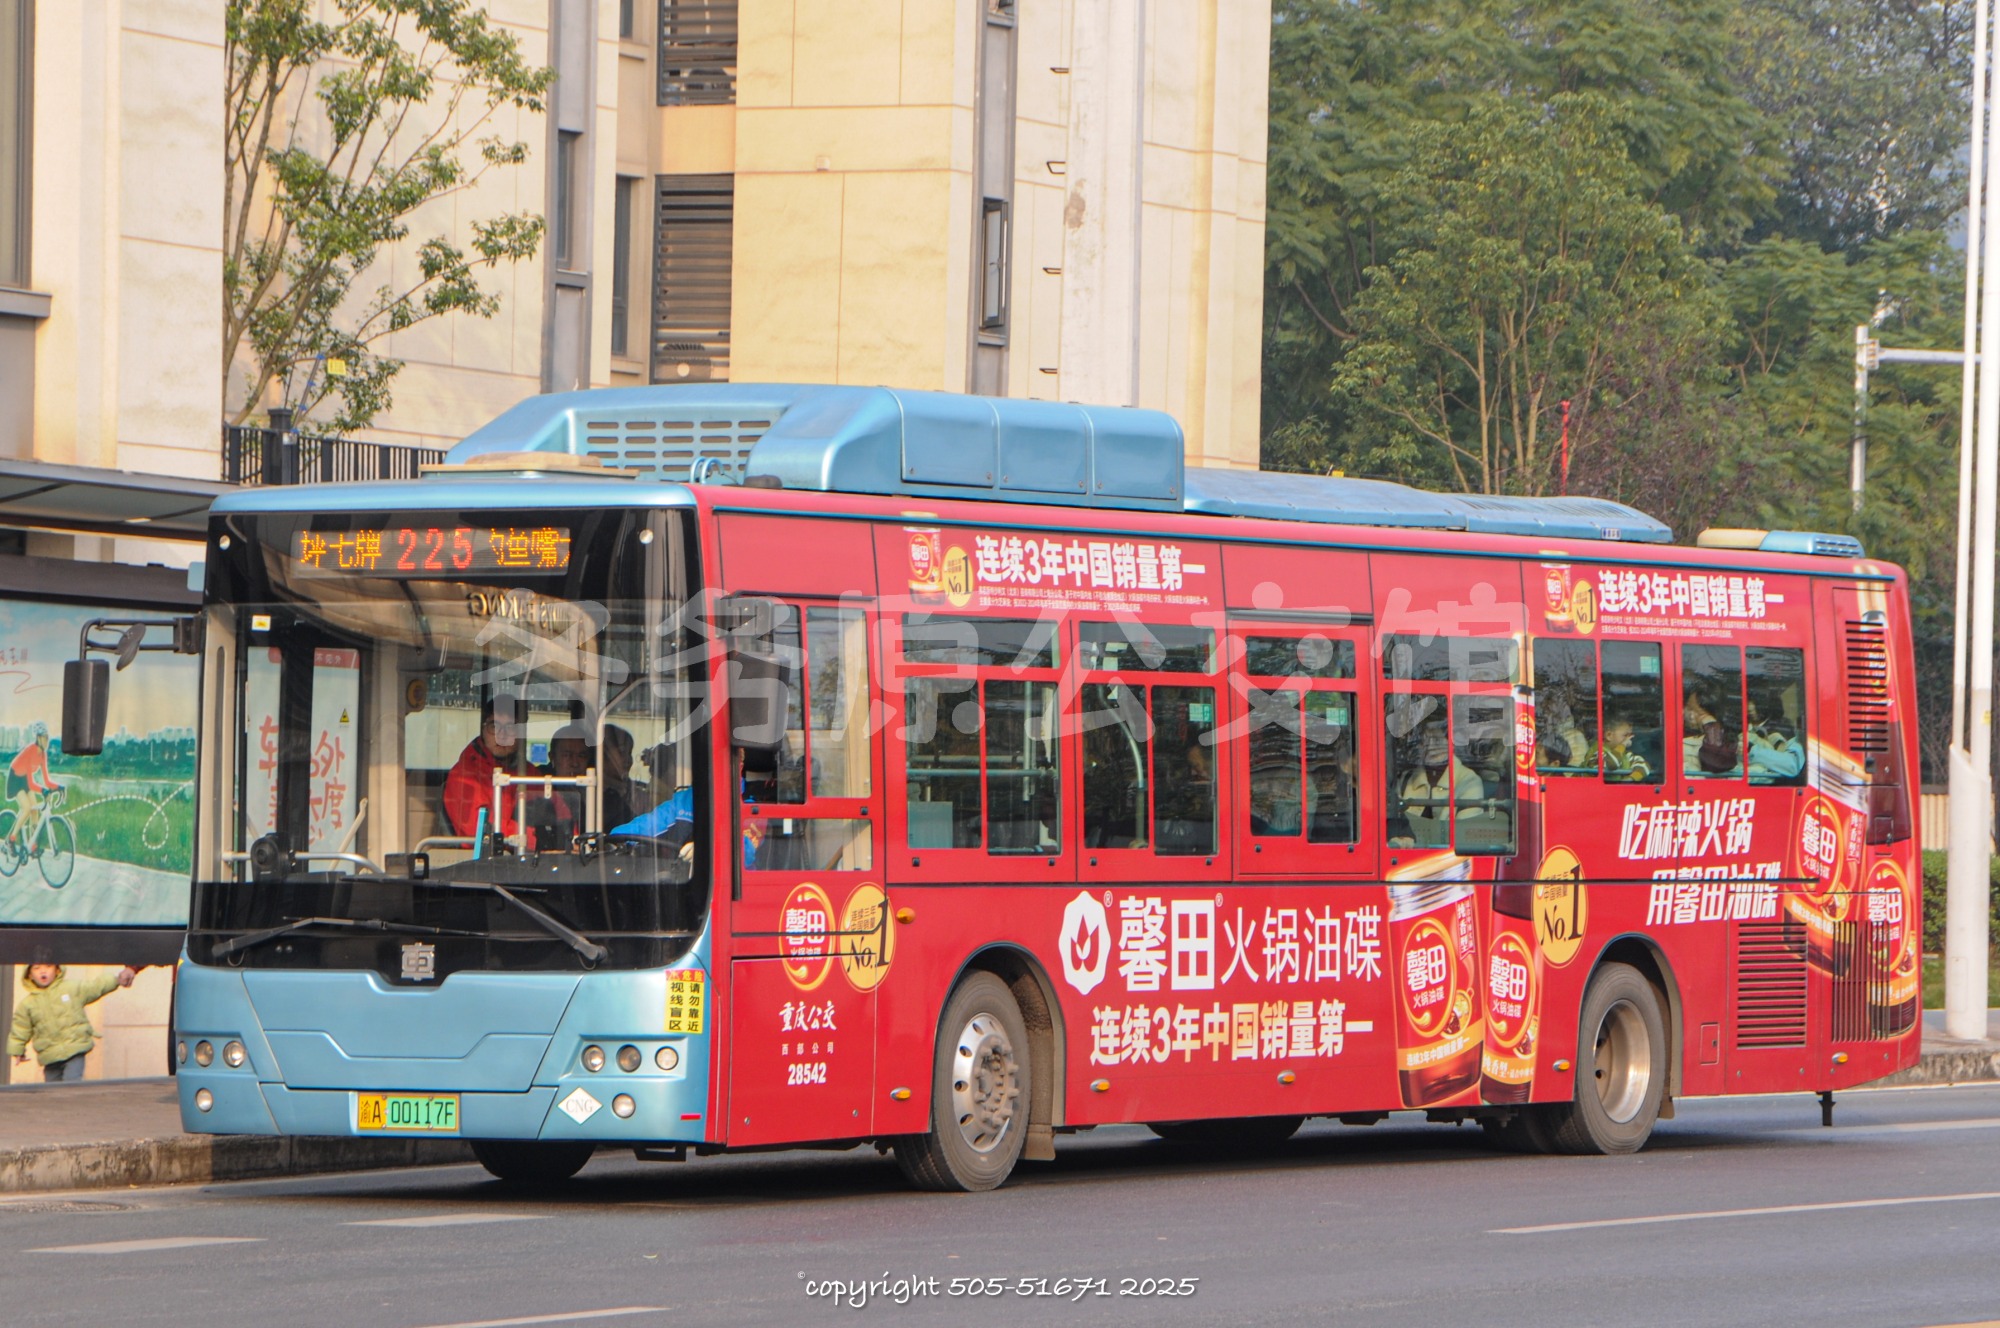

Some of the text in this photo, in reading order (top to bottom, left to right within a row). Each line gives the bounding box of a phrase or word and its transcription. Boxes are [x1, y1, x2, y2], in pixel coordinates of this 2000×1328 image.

[397, 527, 474, 570] 225
[975, 534, 1206, 592] 连续3年中国销量第一
[1598, 570, 1785, 619] 连续3年中国销量第一
[1618, 798, 1756, 860] 吃麻辣火锅
[1801, 813, 1837, 865] 馨田
[1540, 863, 1584, 947] No.1
[1646, 861, 1782, 926] 用馨田油碟
[785, 907, 826, 946] 馨田
[846, 898, 890, 973] No.1
[1406, 944, 1447, 992] 馨田
[1489, 954, 1527, 1001] 馨田
[669, 981, 684, 1031] 视线盲区
[688, 982, 701, 1032] 请勿靠近
[778, 1000, 838, 1033] 重庆公交
[1412, 985, 1446, 1010] 火锅油碟
[1491, 999, 1523, 1019] 火锅油碟
[781, 1041, 835, 1056] 西部公司
[1089, 998, 1374, 1067] 连续3年中国销量第一
[787, 1062, 828, 1086] 28542
[390, 1100, 456, 1125] 00117F
[565, 1099, 594, 1114] CNG
